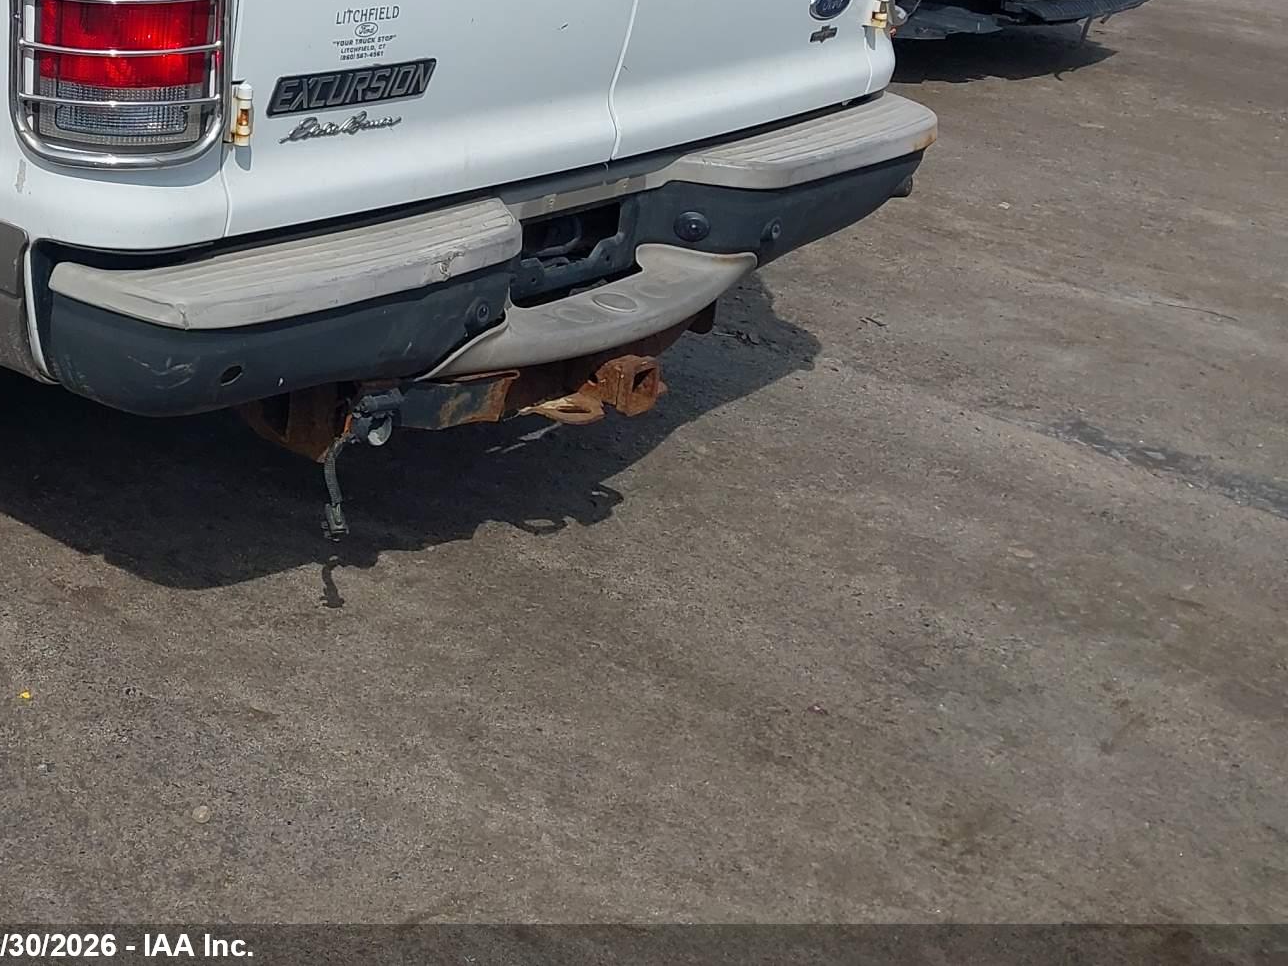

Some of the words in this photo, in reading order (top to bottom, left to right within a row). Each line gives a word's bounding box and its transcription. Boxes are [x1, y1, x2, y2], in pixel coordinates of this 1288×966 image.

[336, 5, 400, 24] LITCHFIELD
[355, 37, 376, 45] TRUCK
[272, 61, 436, 114] EXCURSION
[278, 115, 343, 145] Eddie
[342, 110, 403, 136] Bauer
